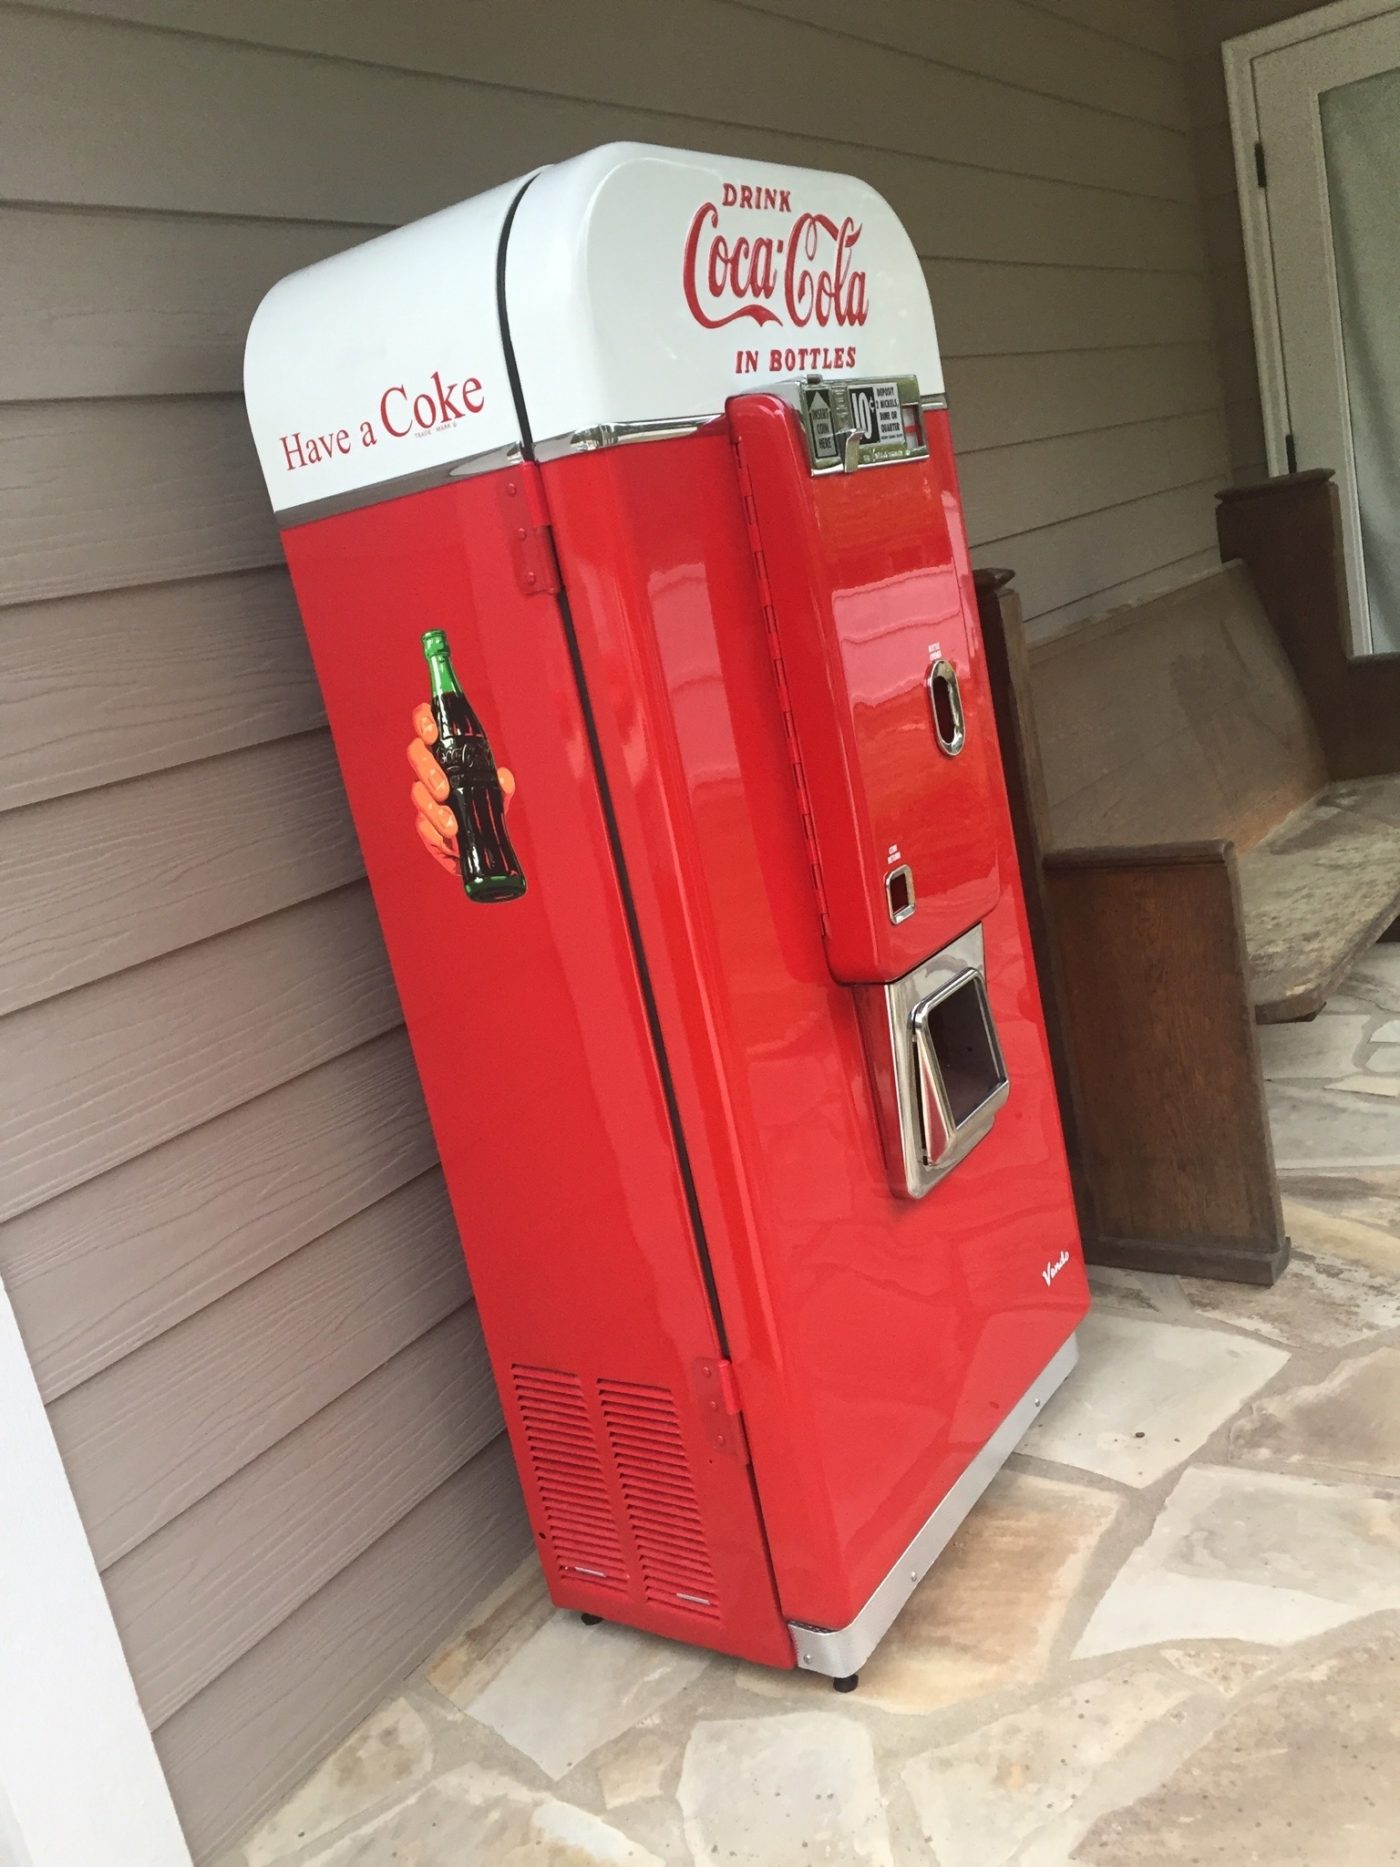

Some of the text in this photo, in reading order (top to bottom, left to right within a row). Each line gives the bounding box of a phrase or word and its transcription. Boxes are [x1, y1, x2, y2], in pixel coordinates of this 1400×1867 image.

[722, 182, 792, 213] DRINK
[683, 202, 870, 329] Coca-Cola
[735, 346, 857, 374] IN BOTTLES
[279, 371, 485, 471] Have a Coke
[1042, 1250, 1070, 1288] Vendo
